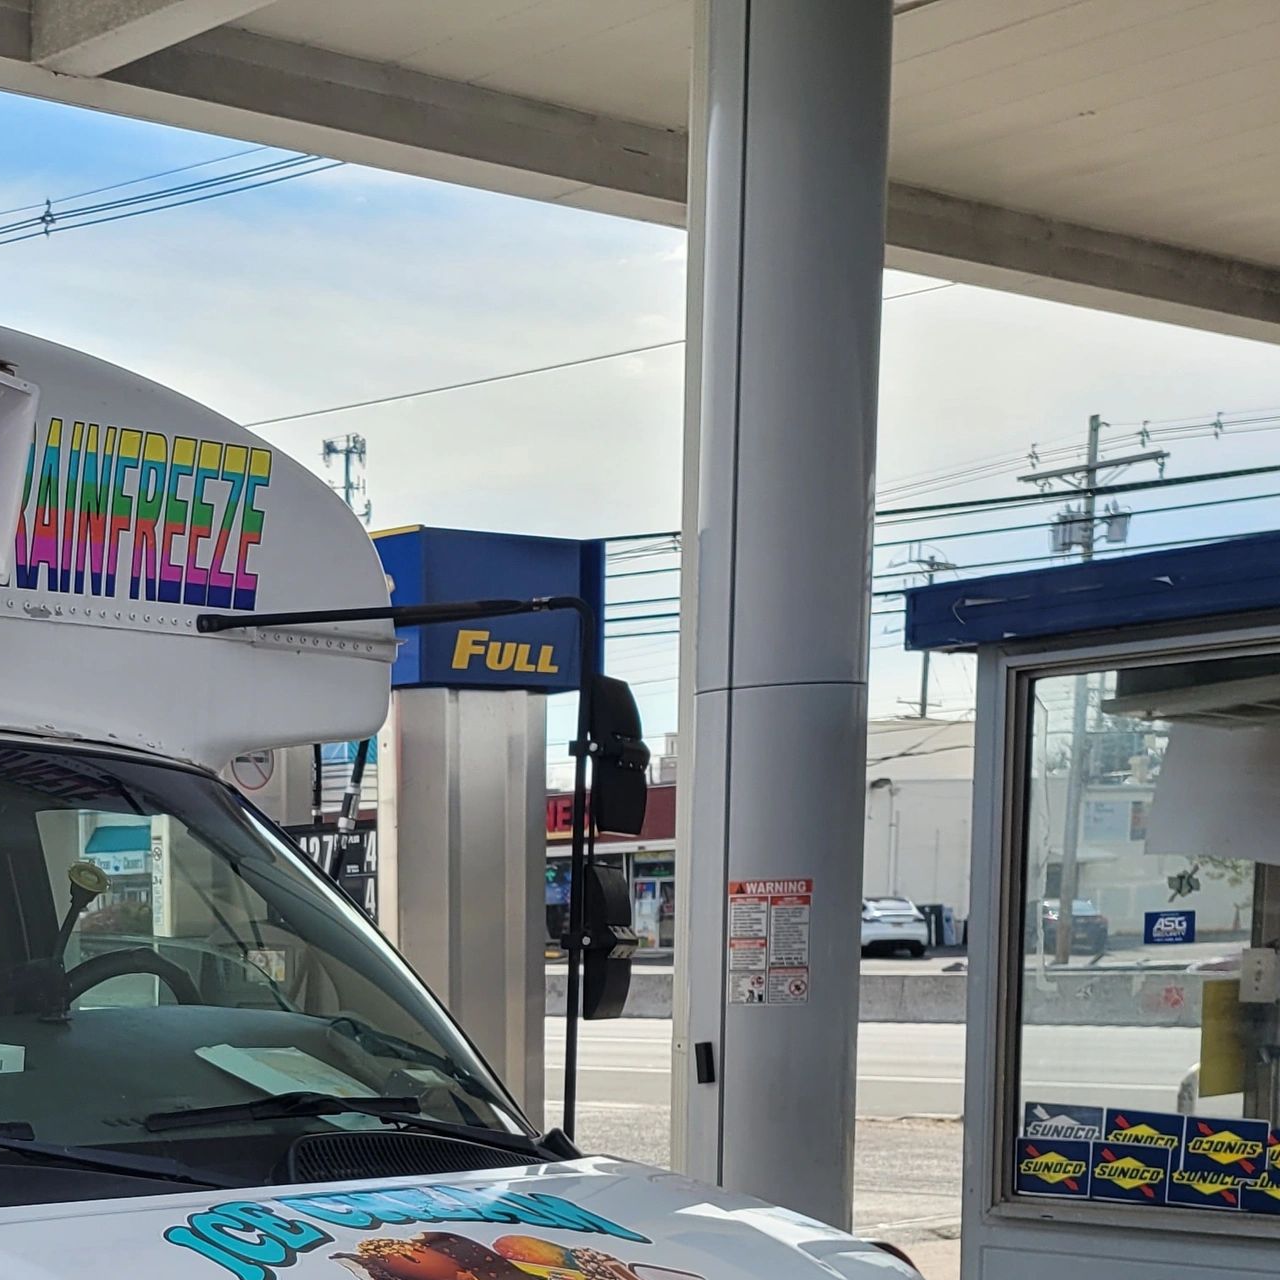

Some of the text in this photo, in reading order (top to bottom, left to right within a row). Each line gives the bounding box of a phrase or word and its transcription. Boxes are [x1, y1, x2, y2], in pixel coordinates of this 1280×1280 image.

[746, 881, 807, 894] WARNING
[1029, 1123, 1097, 1140] SUNOCO
[1022, 1160, 1084, 1175] SUNOCO
[1095, 1164, 1161, 1182] SUNOCO
